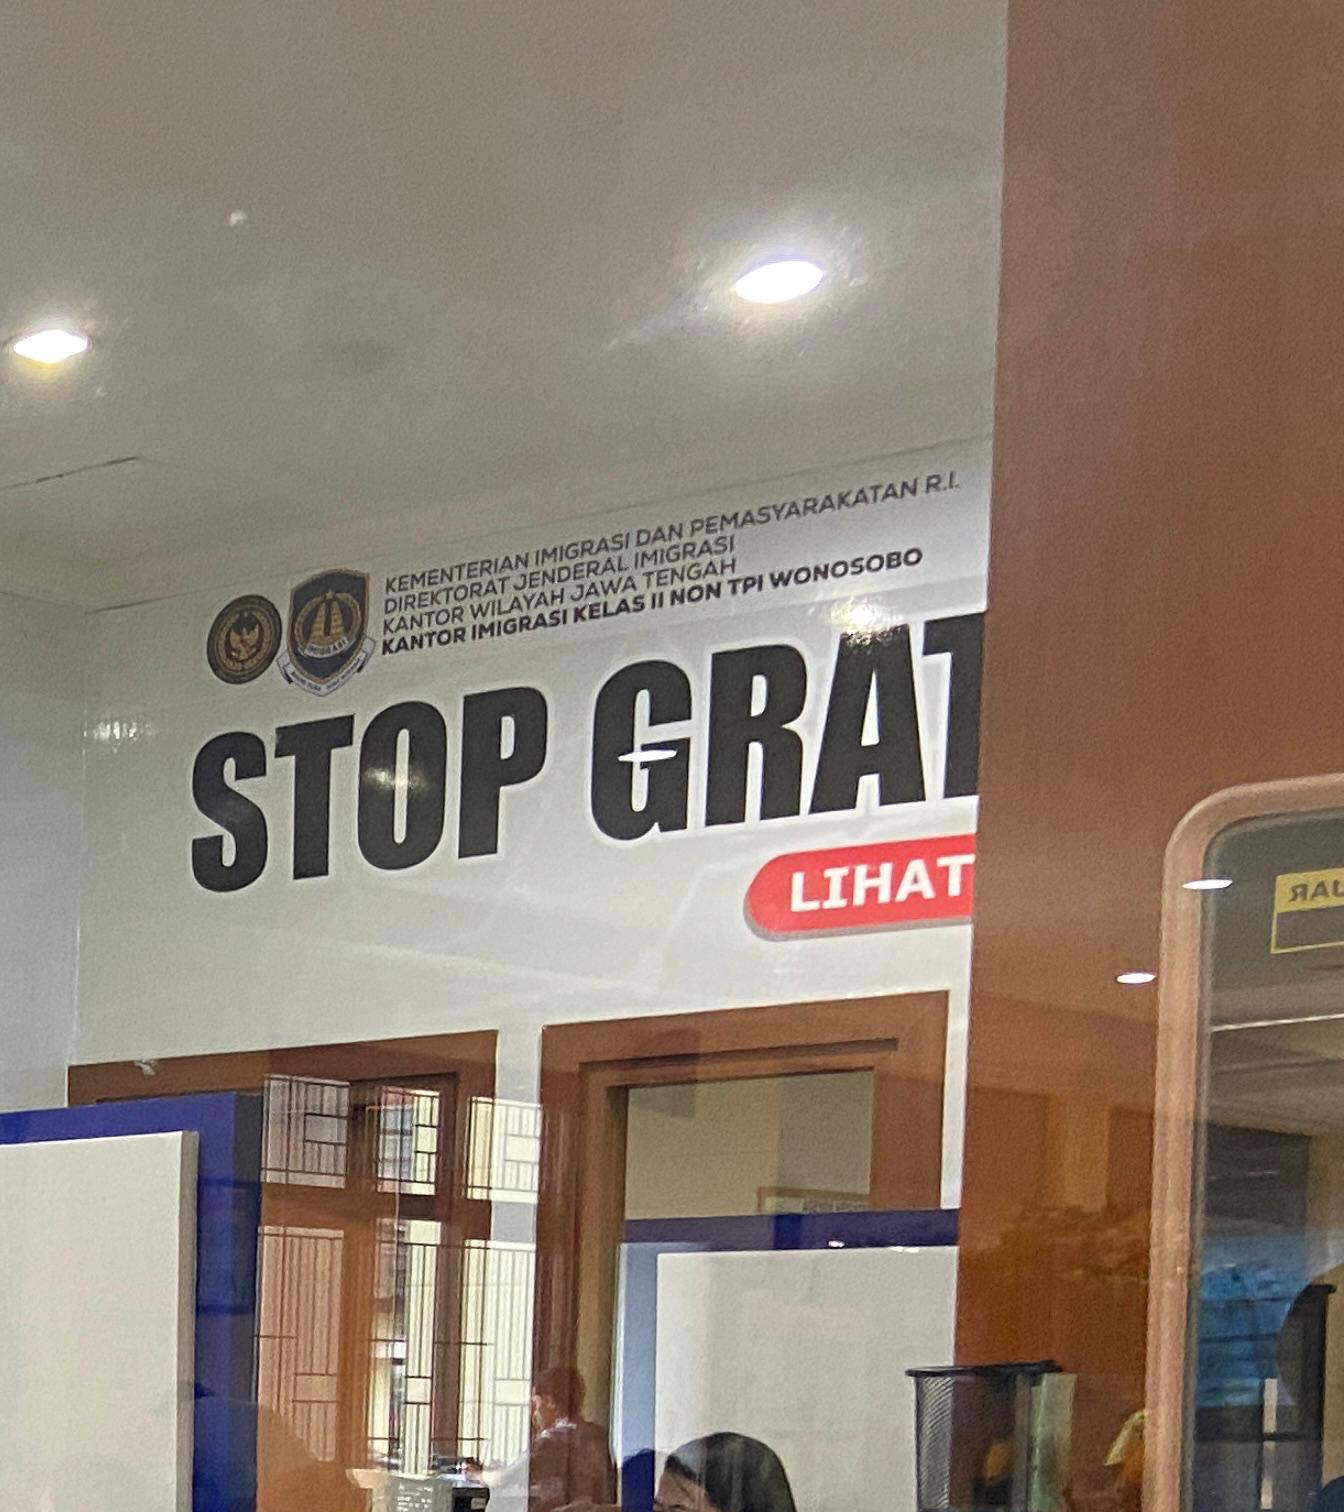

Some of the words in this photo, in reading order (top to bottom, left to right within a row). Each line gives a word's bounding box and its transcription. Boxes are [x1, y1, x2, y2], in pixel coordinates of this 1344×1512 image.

[384, 577, 510, 614] DIREKTORAT
[513, 557, 629, 591] JENDERAL
[634, 534, 735, 570] IMIGRASI
[385, 552, 529, 594] KEMENTERIAN
[535, 533, 629, 566] IMIGRASI
[636, 523, 683, 547] DAN
[690, 478, 918, 536] PEMASYARAKATAN
[925, 471, 960, 494] R.I.
[382, 627, 466, 655] KANTOR
[471, 608, 567, 640] IMIGRASI
[573, 595, 645, 623] KELAS
[651, 592, 663, 610] II
[670, 581, 722, 606] NON
[727, 574, 763, 596] TPI
[769, 548, 923, 589] WONOSOBO
[383, 607, 464, 635] KANTOR
[470, 588, 564, 619] WILAYAH
[570, 575, 637, 602] JAWA
[643, 558, 736, 588] TENGAH
[191, 686, 547, 892] STOP
[591, 612, 984, 841] GRAT
[790, 854, 975, 912] LIHAT
